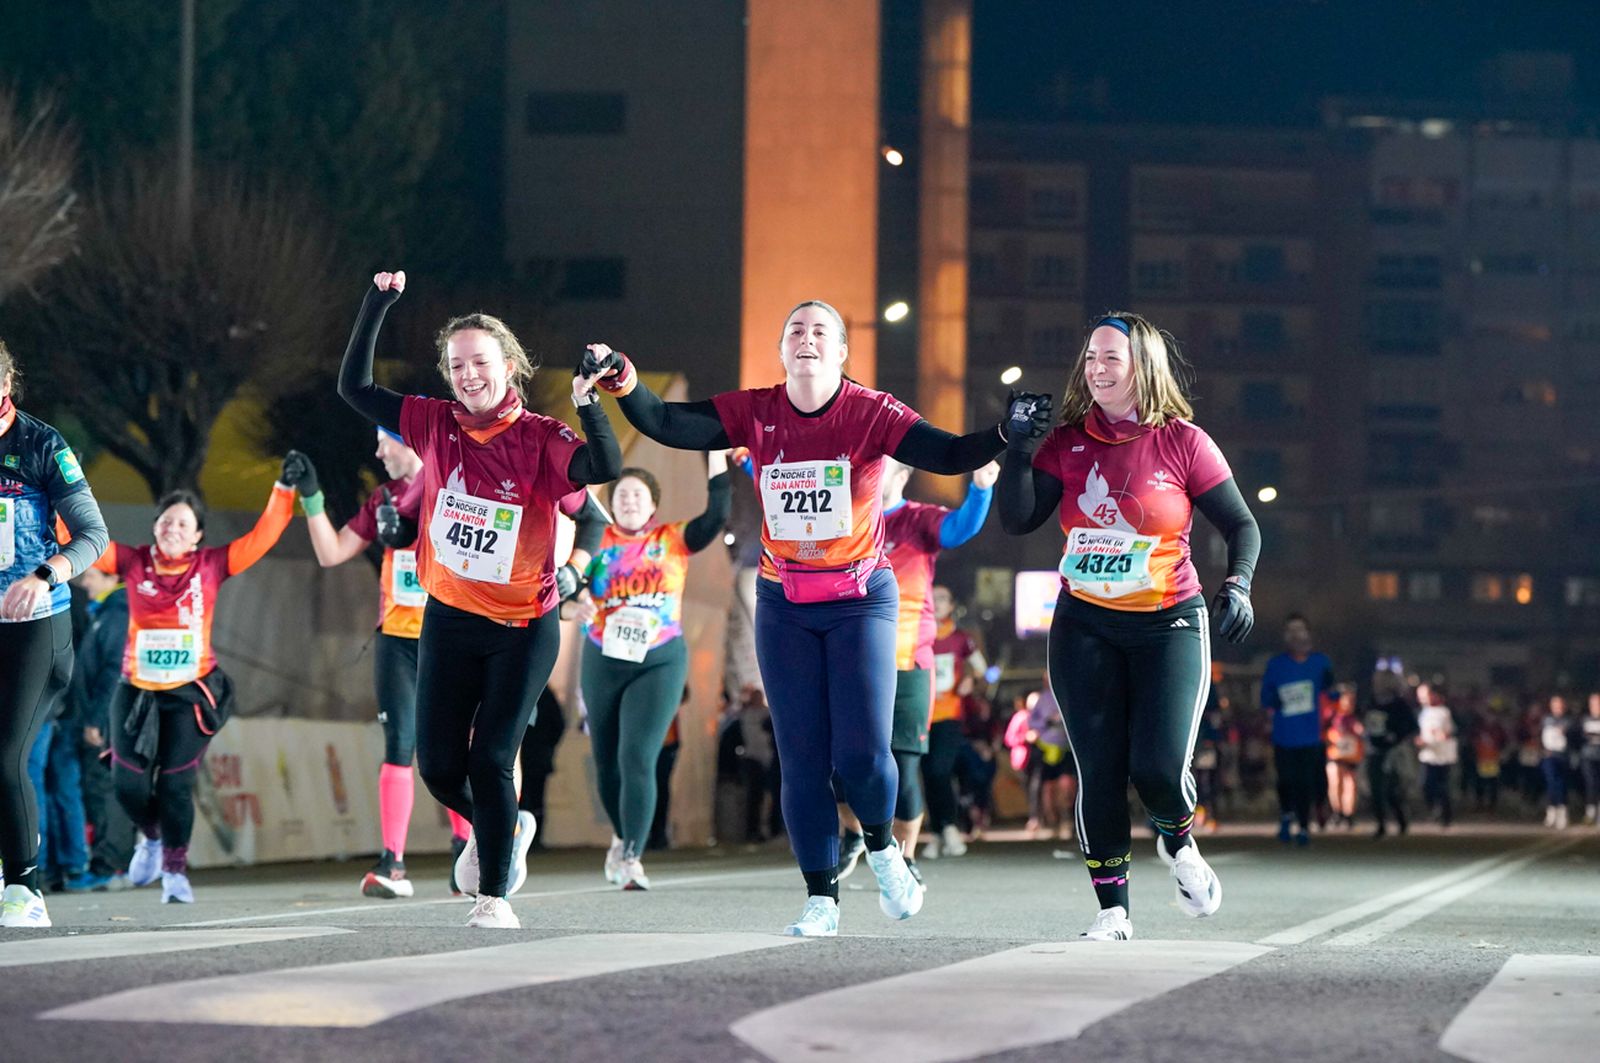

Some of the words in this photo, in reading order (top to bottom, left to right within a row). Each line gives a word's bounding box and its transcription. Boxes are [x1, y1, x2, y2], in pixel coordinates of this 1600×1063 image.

[780, 471, 806, 480] NOCHE
[806, 469, 817, 478] DE
[770, 481, 787, 490] SAN
[788, 478, 817, 490] ANTÓN
[455, 501, 478, 514] NOCHE
[477, 507, 488, 517] DE
[780, 490, 832, 514] 2212
[443, 509, 460, 521] SAN
[460, 512, 487, 527] ANTÓN
[1093, 503, 1118, 526] 43
[446, 522, 498, 555] 4512
[1074, 545, 1091, 554] SAN
[1075, 553, 1134, 574] 4325
[610, 568, 664, 598] HOY
[146, 650, 190, 666] 12372
